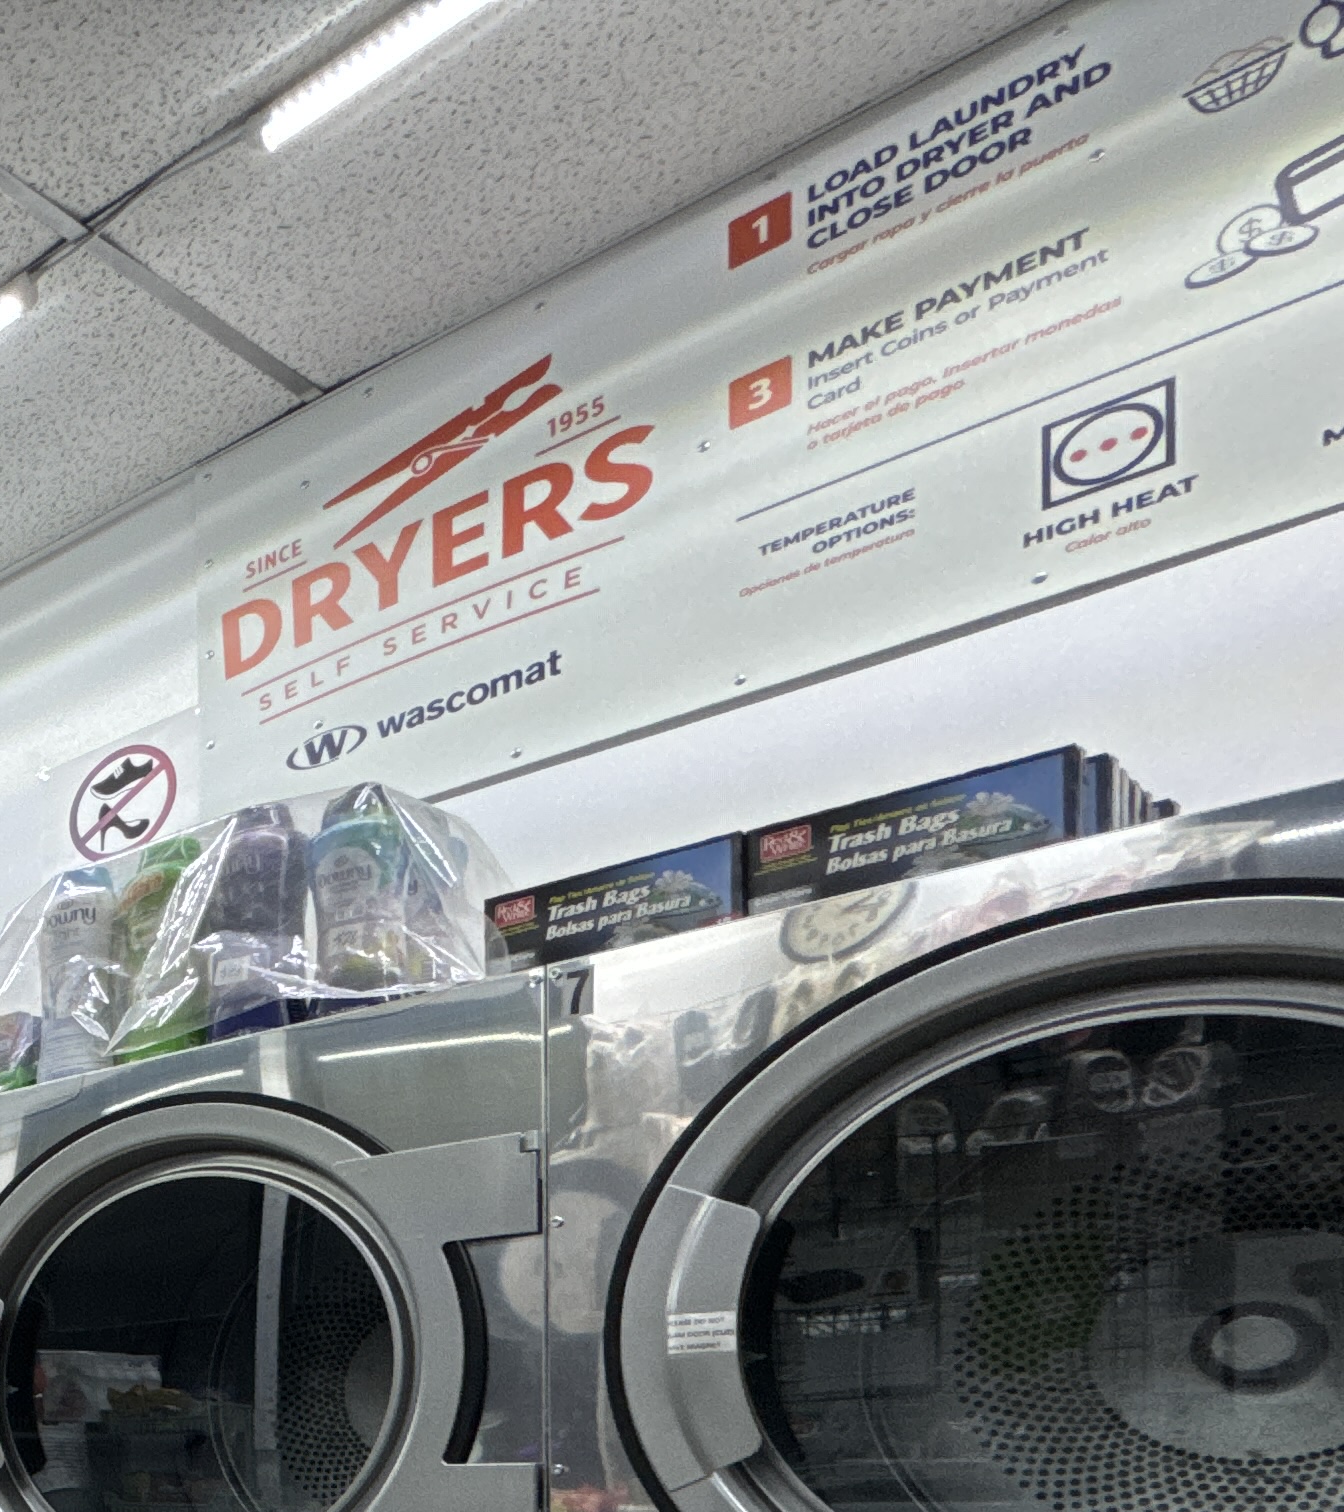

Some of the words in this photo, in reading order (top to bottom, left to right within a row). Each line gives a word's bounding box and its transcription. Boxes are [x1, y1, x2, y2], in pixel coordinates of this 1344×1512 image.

[807, 143, 899, 204] LOAD
[909, 43, 1087, 150] LAUNDRY
[807, 175, 886, 228] INTO
[896, 112, 1015, 183] DRYER
[1025, 61, 1113, 119] AND
[806, 185, 917, 250] CLOSE
[924, 126, 1033, 196] DOOR
[806, 239, 868, 275] Cargar
[872, 216, 916, 247] ropa
[936, 184, 992, 215] cierre
[995, 167, 1015, 185] la
[1018, 132, 1091, 178] puerta
[751, 214, 769, 244] 1
[806, 309, 906, 369] MAKE
[914, 226, 1090, 322] PAYMENT
[807, 353, 875, 391] Insert
[880, 320, 948, 359] Coins
[954, 306, 981, 327] or
[988, 247, 1110, 313] Payment
[747, 377, 774, 411] 3
[806, 376, 862, 411] Card
[807, 403, 861, 436] Hacer
[863, 398, 881, 418] el
[1023, 295, 1123, 349] monedas
[546, 395, 606, 438] 1955
[821, 413, 884, 447] tarjeta
[886, 397, 912, 418] de
[914, 378, 967, 410] pago
[758, 486, 916, 557] TEMPERATURE
[811, 508, 916, 556] OPTIONS:
[1022, 508, 1101, 549] HIGH
[1111, 473, 1201, 518] HEAT
[1064, 531, 1113, 555] Calor
[1115, 516, 1154, 538] alto
[221, 424, 656, 681] DRYERS
[244, 537, 304, 580] SINCE
[738, 567, 802, 598] Opciones
[803, 560, 822, 576] de
[823, 527, 916, 569] temperatura
[258, 656, 351, 712] SELF
[382, 565, 584, 657] SERVICE
[376, 649, 564, 740] wascomat
[825, 846, 889, 876] Bolsas
[891, 836, 938, 864] para
[940, 818, 1013, 848] Basura
[828, 822, 893, 854] Trash
[897, 807, 961, 838] Bags
[48, 906, 96, 926] owny
[544, 915, 595, 942] Bolsas
[596, 908, 633, 933] para
[635, 894, 692, 920] Basura
[546, 895, 598, 924] Trash
[601, 883, 653, 909] Bags
[566, 969, 590, 1015] 7
